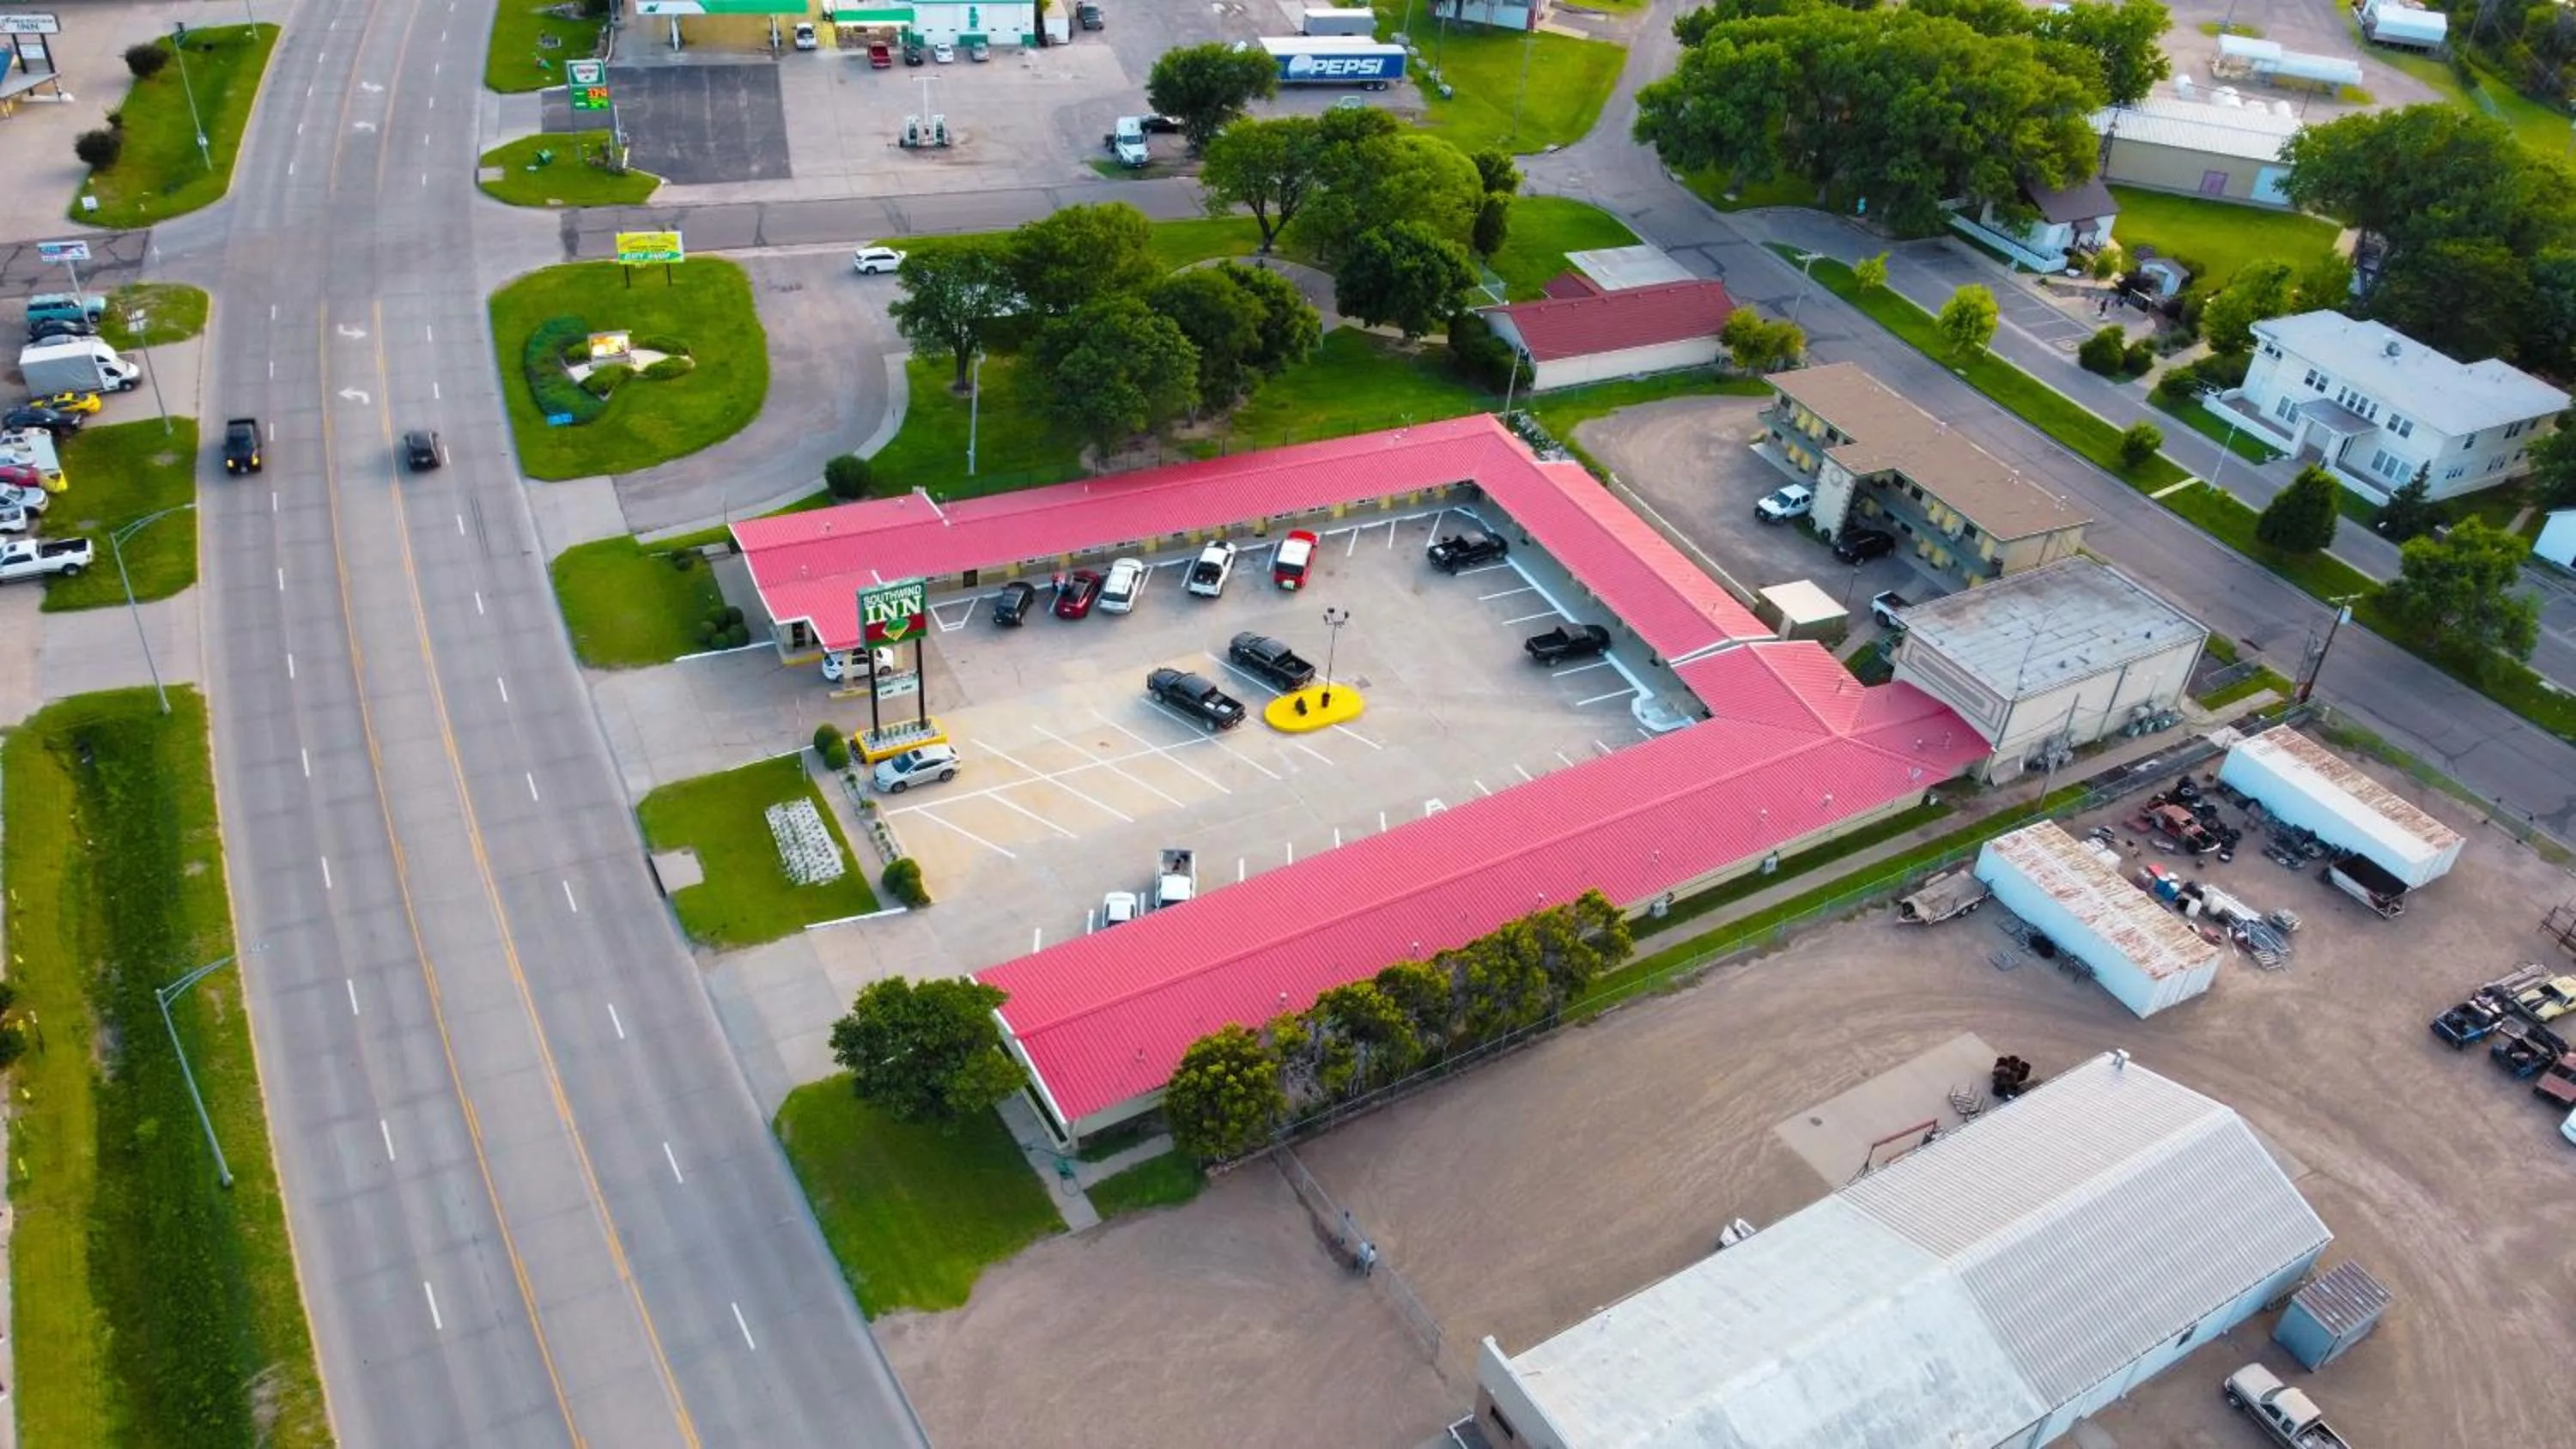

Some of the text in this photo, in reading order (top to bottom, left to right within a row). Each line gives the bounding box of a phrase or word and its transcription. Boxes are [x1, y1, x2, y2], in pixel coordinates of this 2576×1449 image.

[1309, 58, 1385, 75] PEPSI
[864, 585, 921, 606] SOUTHWIND
[866, 594, 922, 625] INN
